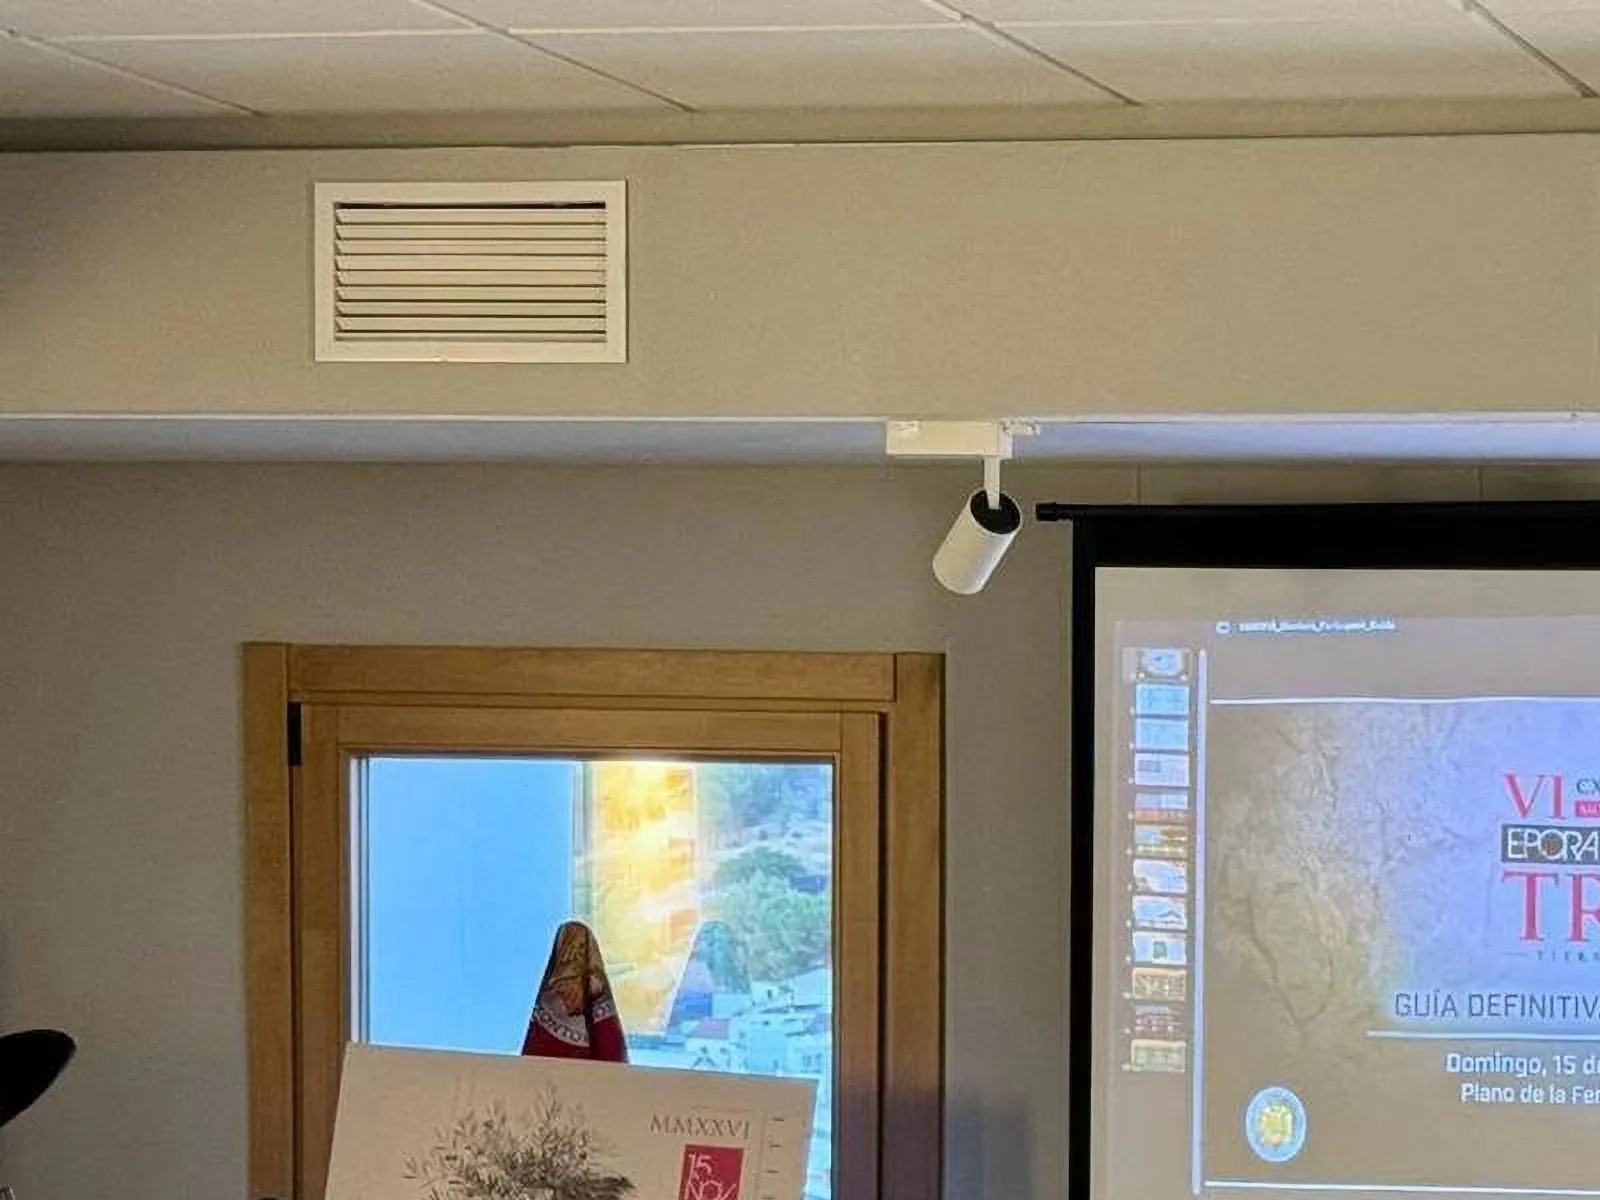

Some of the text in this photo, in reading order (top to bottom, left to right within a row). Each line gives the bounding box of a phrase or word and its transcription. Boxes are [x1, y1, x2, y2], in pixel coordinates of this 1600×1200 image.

[1504, 772, 1566, 820] VI
[1507, 828, 1599, 862] EPORA
[1395, 989, 1458, 1018] GUÍA
[1446, 1052, 1547, 1078] Domingo,
[1553, 1055, 1576, 1075] 15
[1460, 1083, 1515, 1104] Plano
[1520, 1084, 1545, 1104] de
[1549, 1085, 1567, 1105] la
[650, 1112, 751, 1140] MMXXVI
